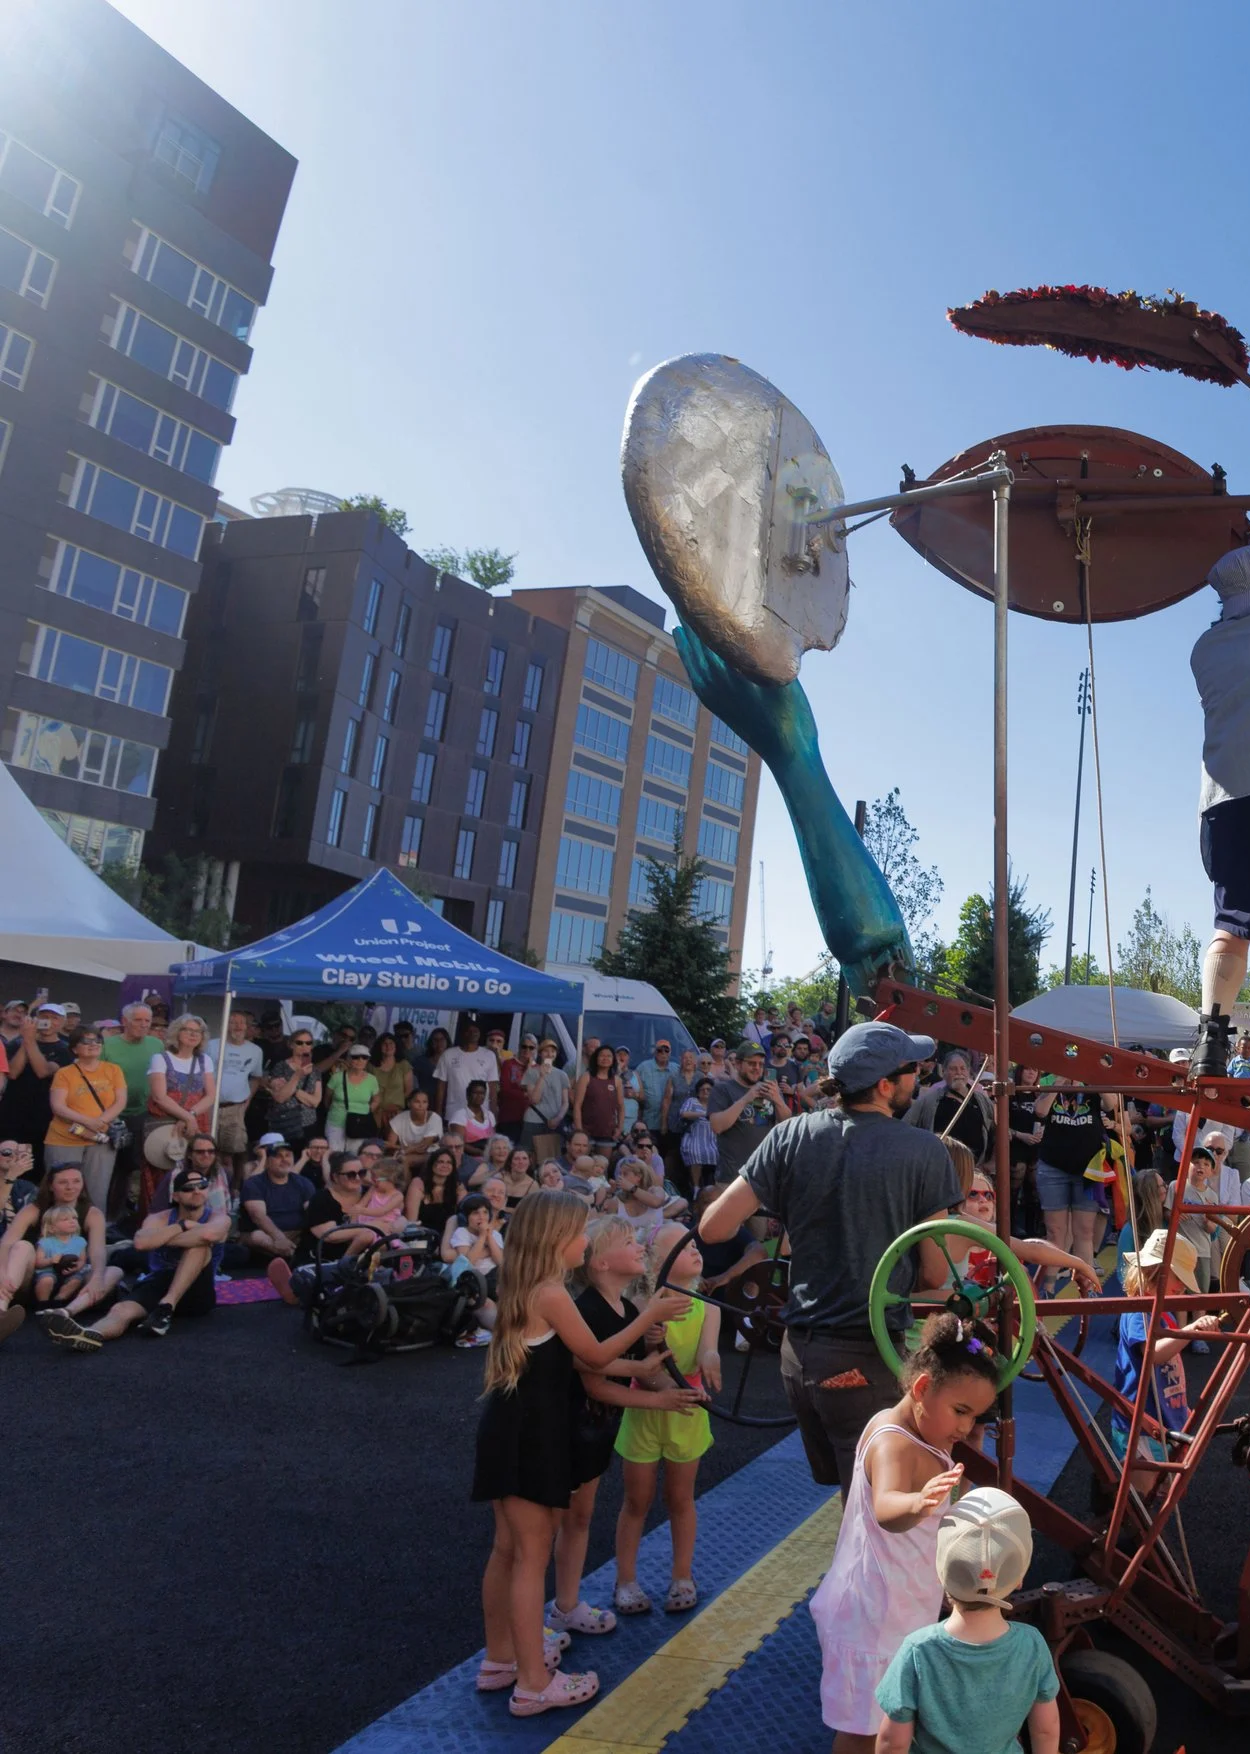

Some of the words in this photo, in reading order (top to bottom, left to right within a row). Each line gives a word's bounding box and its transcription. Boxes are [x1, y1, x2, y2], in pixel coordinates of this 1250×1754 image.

[354, 938, 399, 946] Union
[400, 938, 452, 953] Project
[315, 953, 409, 965] Wheel
[413, 956, 501, 974] Mobile
[322, 967, 373, 991] Clay
[377, 970, 450, 991] Studio
[454, 975, 480, 993] To
[484, 978, 512, 996] Go
[1051, 1115, 1093, 1126] PURRIDE
